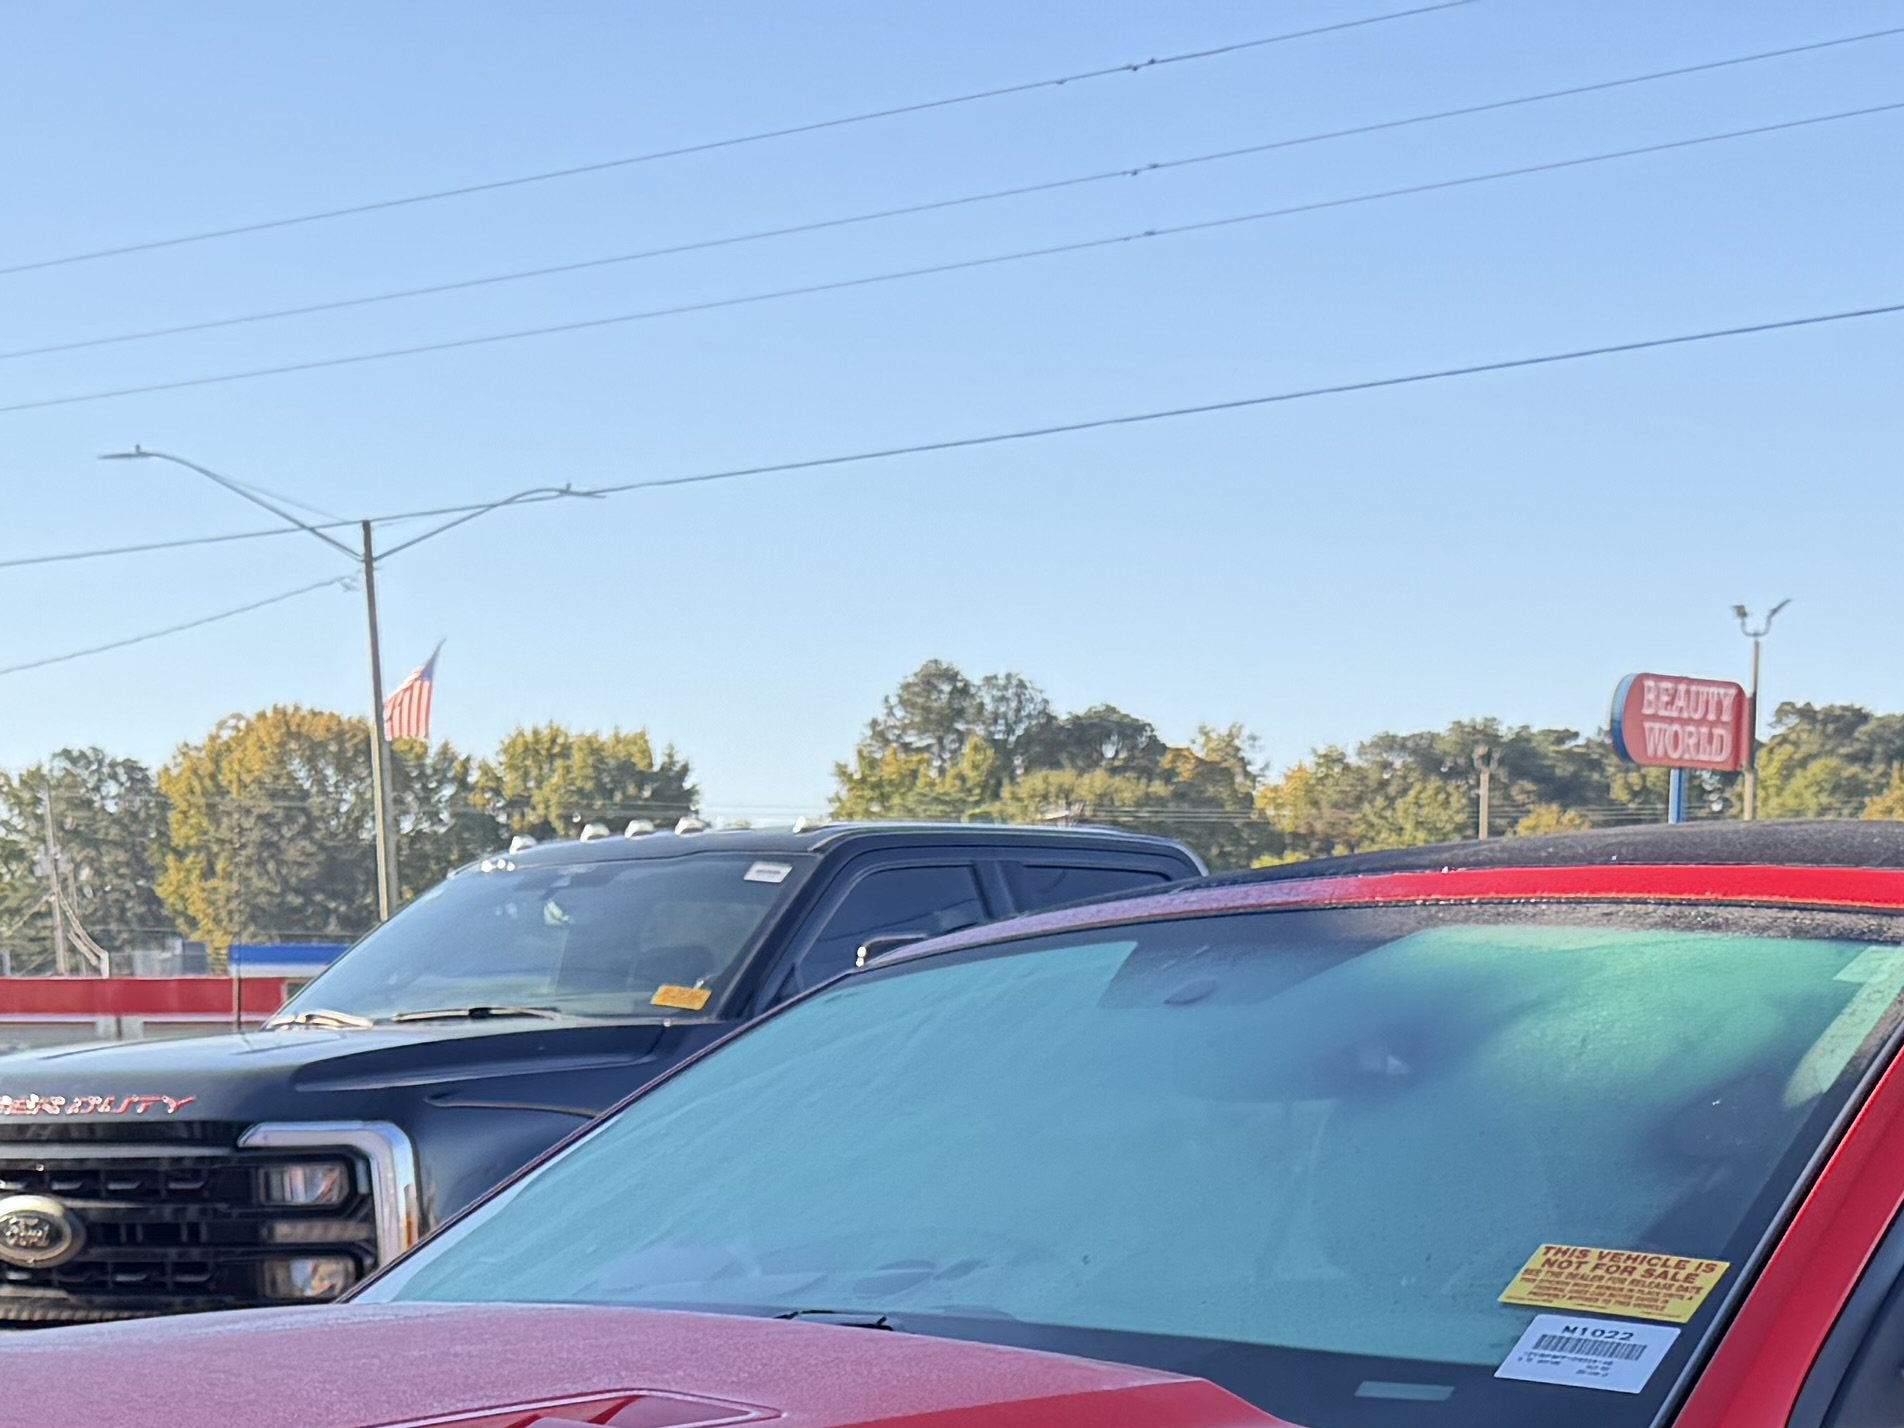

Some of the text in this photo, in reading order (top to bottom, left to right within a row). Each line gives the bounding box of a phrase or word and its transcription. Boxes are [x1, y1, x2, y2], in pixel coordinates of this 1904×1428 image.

[1641, 680, 1737, 722] BEAUTY
[1643, 721, 1733, 762] WORLD
[66, 1095, 194, 1114] DUTY
[1538, 1245, 1719, 1273] THIS VEHICLE IS
[1539, 1257, 1700, 1283] NOT FOR SALE
[1564, 1272, 1605, 1283] DEALER
[1626, 1279, 1676, 1290] RELEASE
[1674, 1284, 1704, 1294] DATE
[1563, 1325, 1634, 1341] M1022
